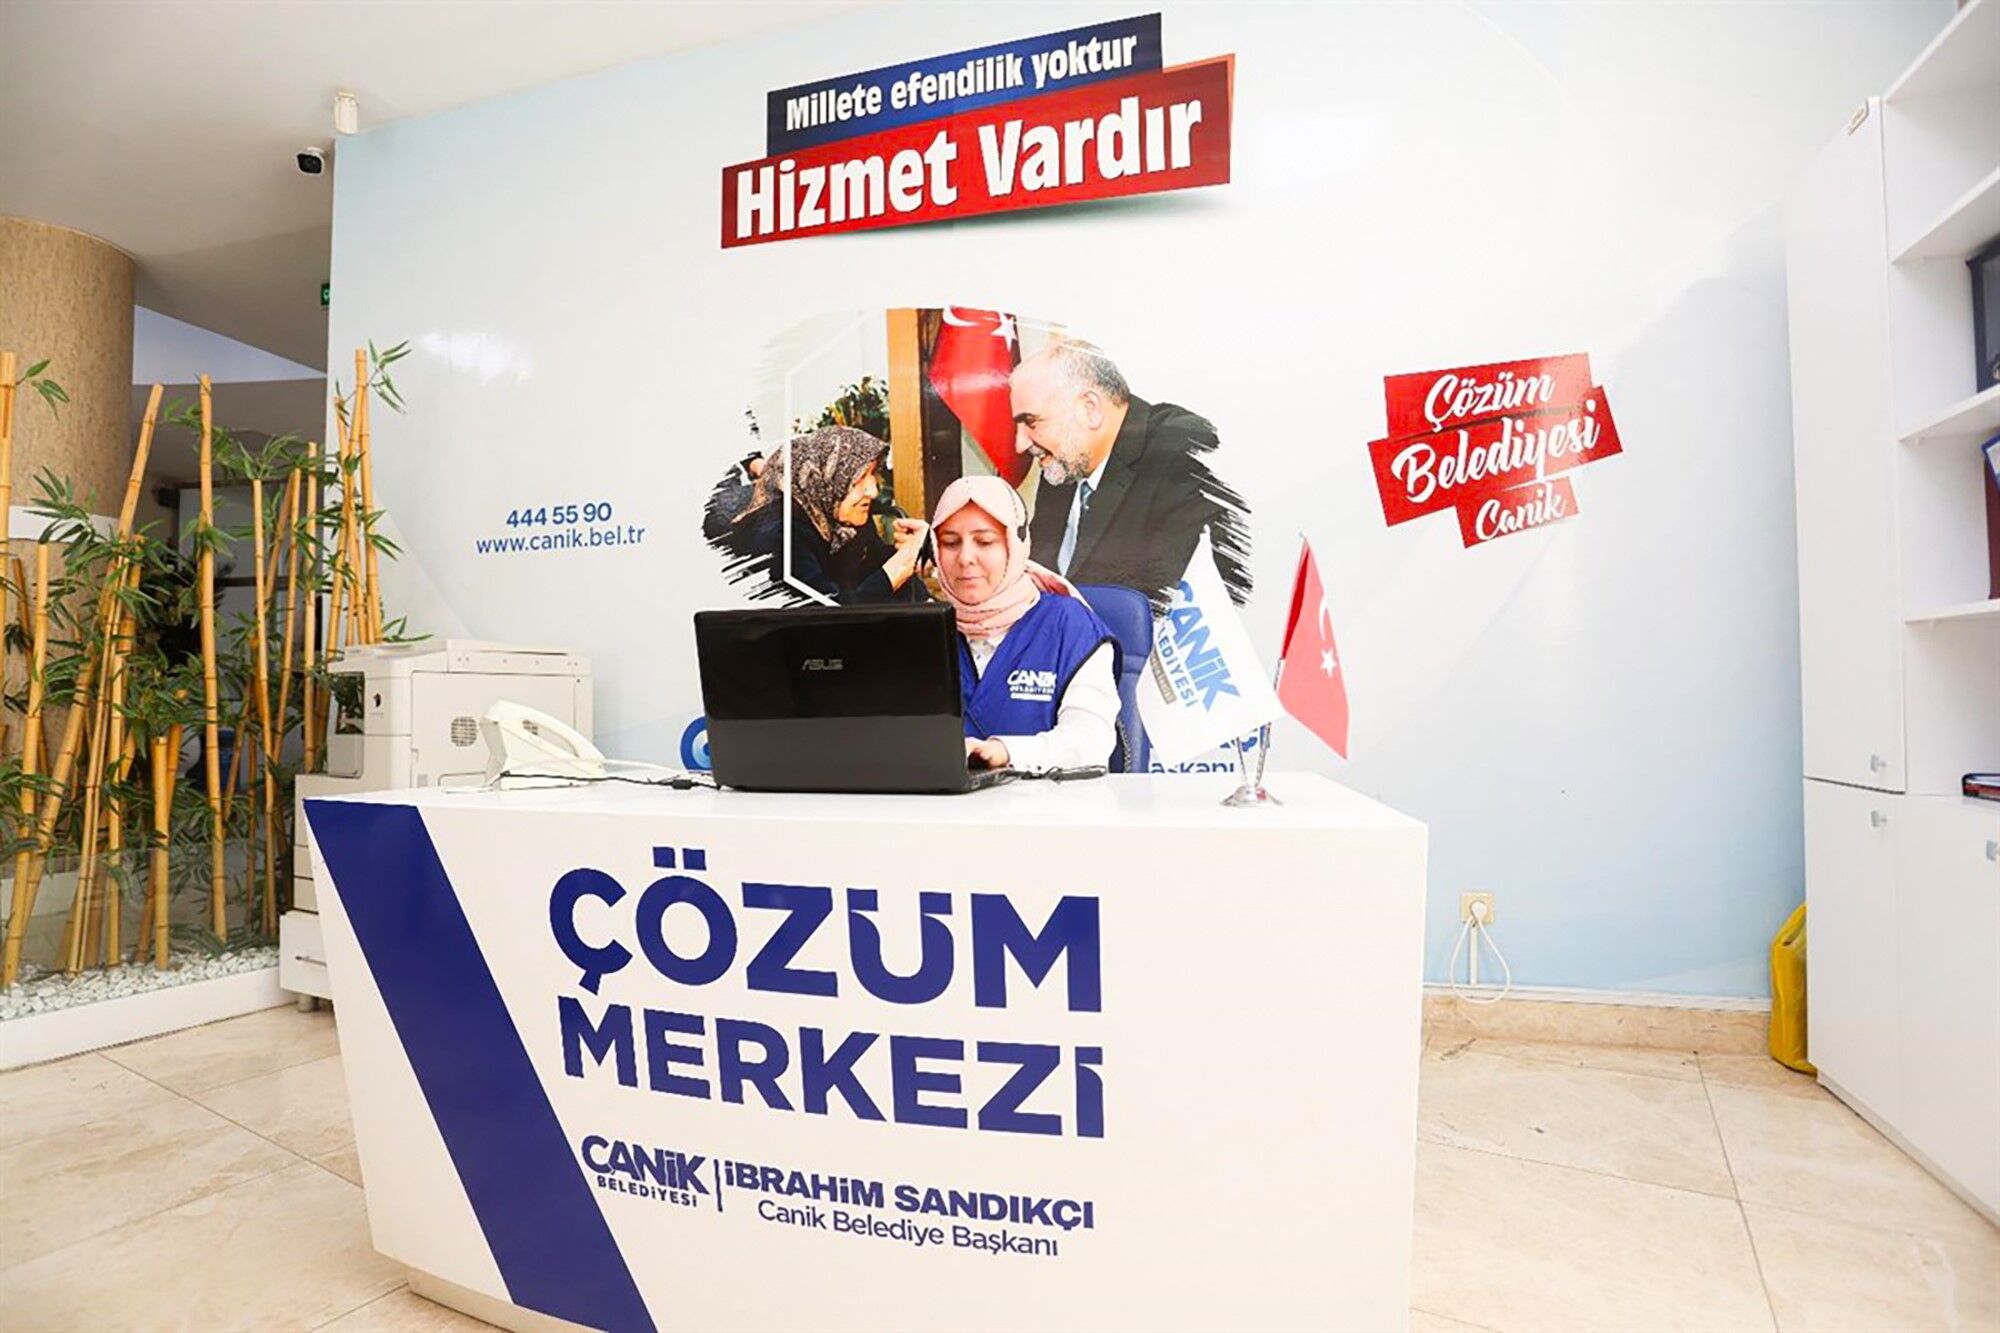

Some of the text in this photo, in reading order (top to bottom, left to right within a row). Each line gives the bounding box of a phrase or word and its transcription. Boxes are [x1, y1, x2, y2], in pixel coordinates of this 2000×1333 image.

[786, 35, 1138, 131] Millete efendilik yoktur
[736, 97, 1202, 240] Hizmet Vardır
[1424, 370, 1556, 433] Çözüm
[1391, 399, 1601, 504] Belediyesi
[475, 524, 646, 554] www.canik.bel.tr
[506, 501, 613, 528] 444 55 90
[1474, 481, 1568, 541] Canik
[801, 658, 844, 671] ASUS
[549, 846, 1103, 1014] ÇÖZÜM
[557, 995, 1105, 1139] MERKEZİ
[757, 1199, 1059, 1257] Canik Belediye Başkanı
[894, 1184, 1094, 1231] SANDIKÇI
